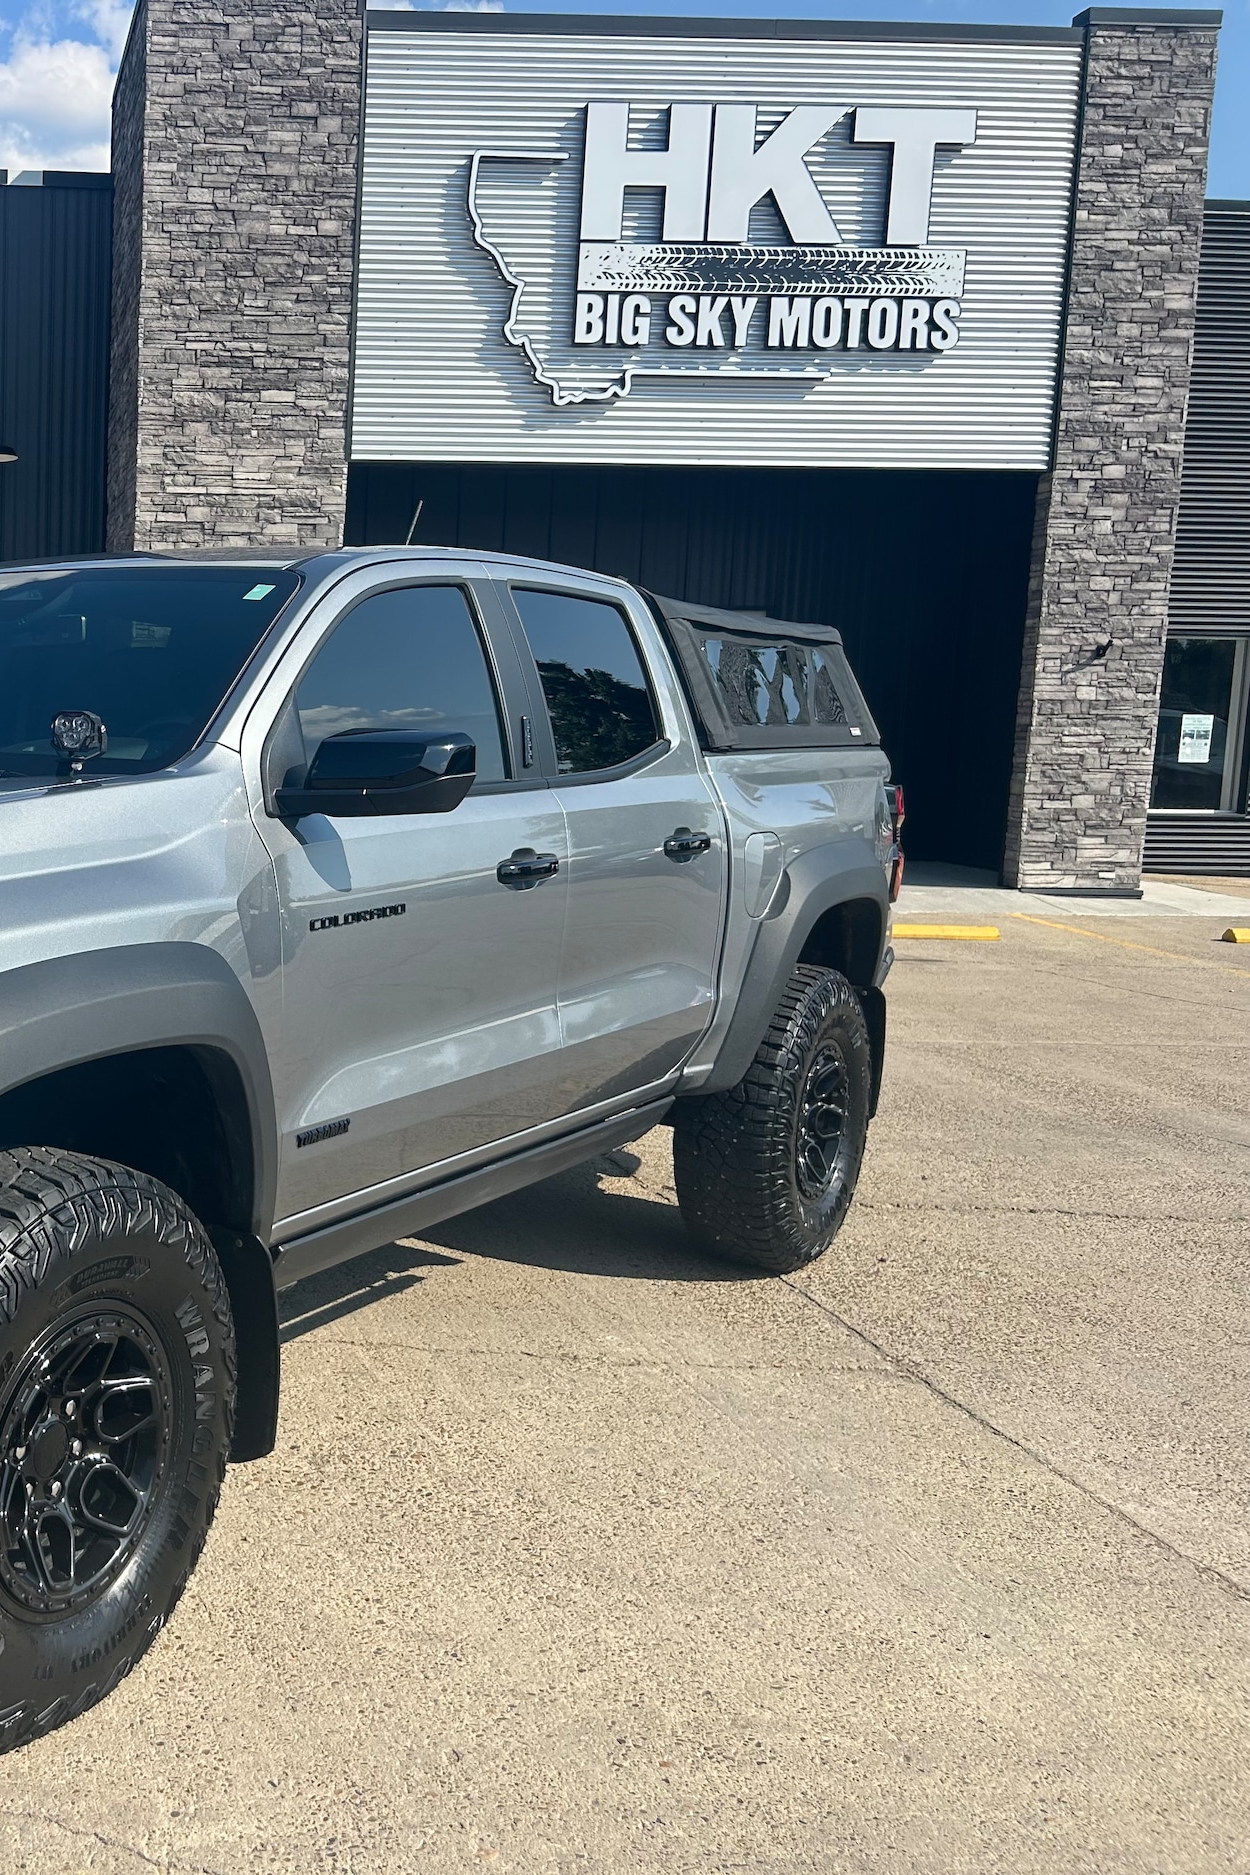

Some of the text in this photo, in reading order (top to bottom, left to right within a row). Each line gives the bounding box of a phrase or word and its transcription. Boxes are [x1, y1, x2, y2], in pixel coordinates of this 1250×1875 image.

[580, 101, 978, 246] HKT
[573, 292, 961, 351] BIG SKY MOTORS
[309, 903, 406, 932] COLORADO
[167, 1291, 217, 1550] WRANGLER
